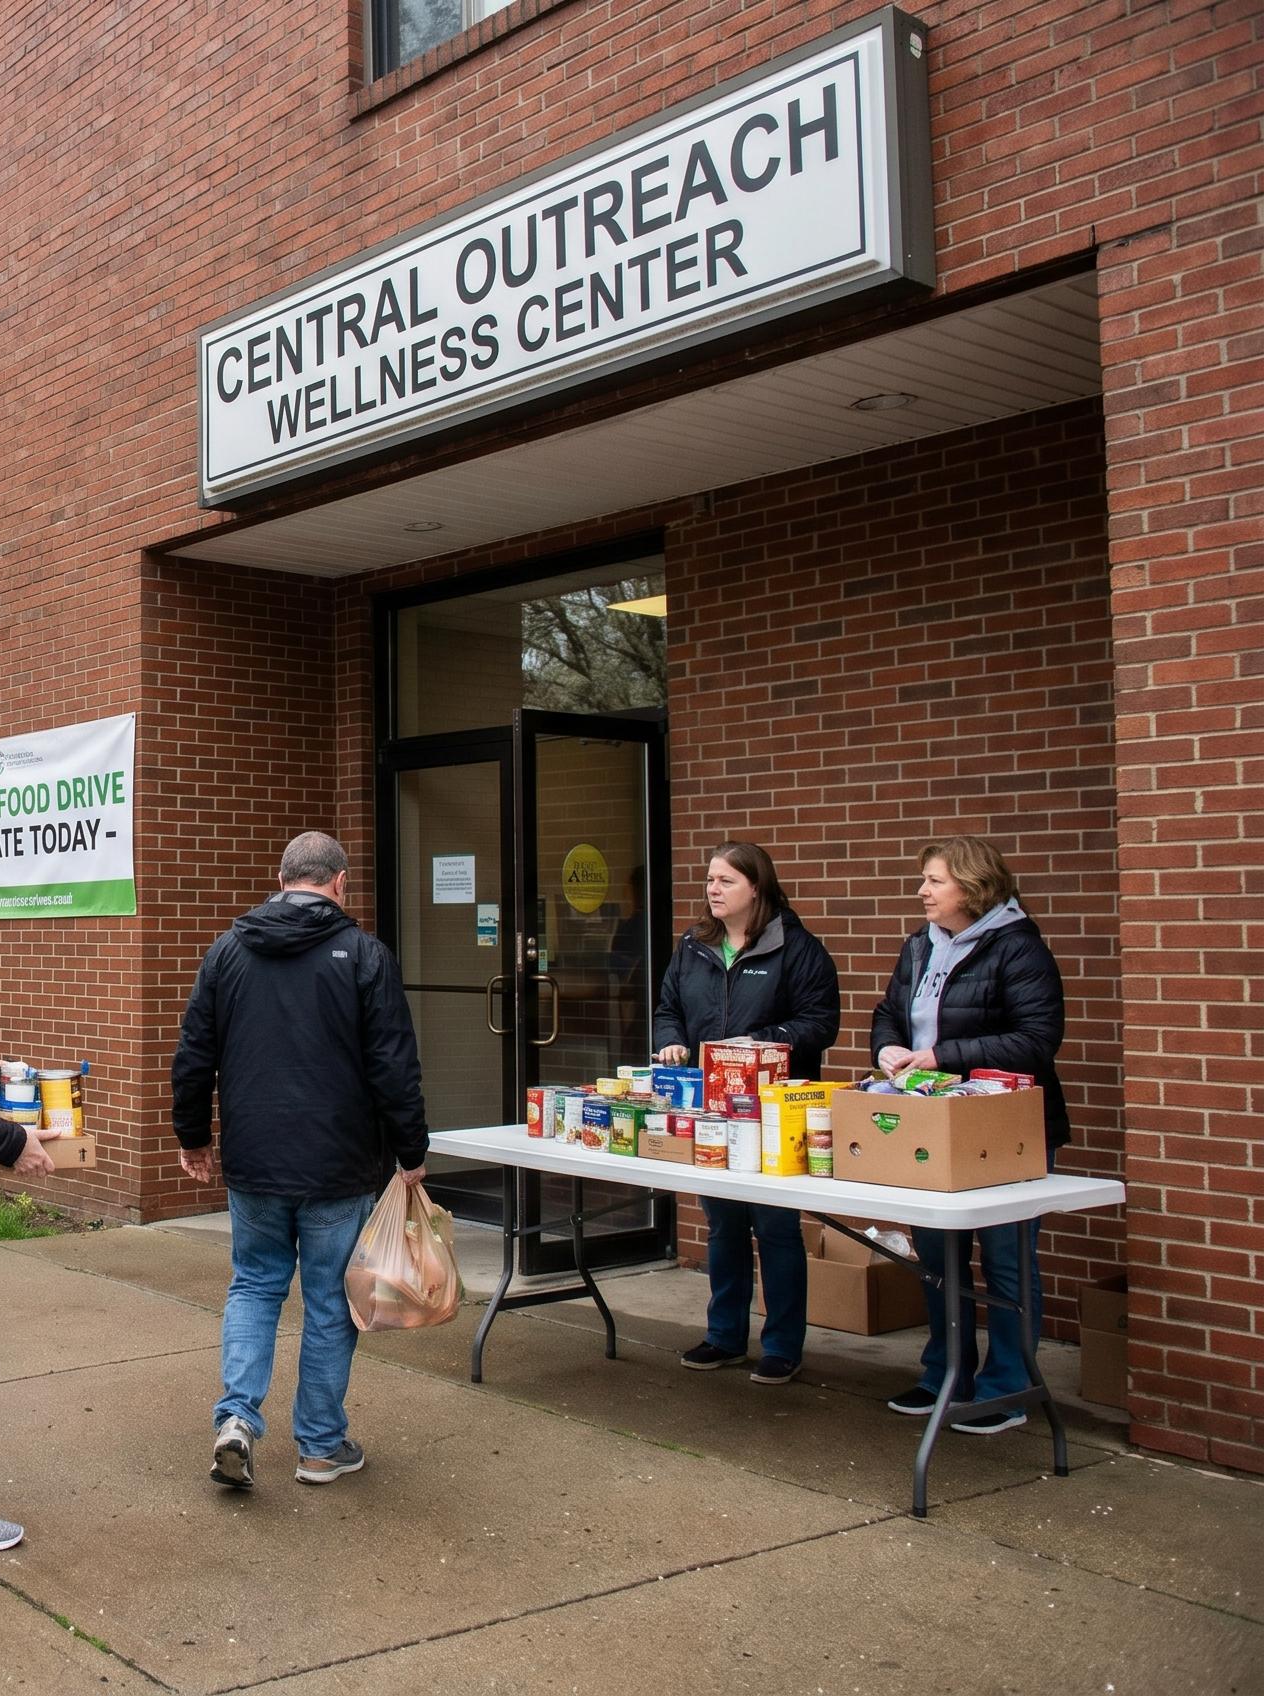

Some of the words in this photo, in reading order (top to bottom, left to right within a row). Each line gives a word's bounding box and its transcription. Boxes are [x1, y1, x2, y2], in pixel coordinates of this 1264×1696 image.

[217, 266, 437, 403] CENTRAL
[456, 84, 838, 305] OUTREACH
[267, 314, 499, 444] WELLNESS
[517, 219, 748, 353] CENTER
[29, 818, 101, 855] TODAY
[57, 771, 125, 811] DRIVE
